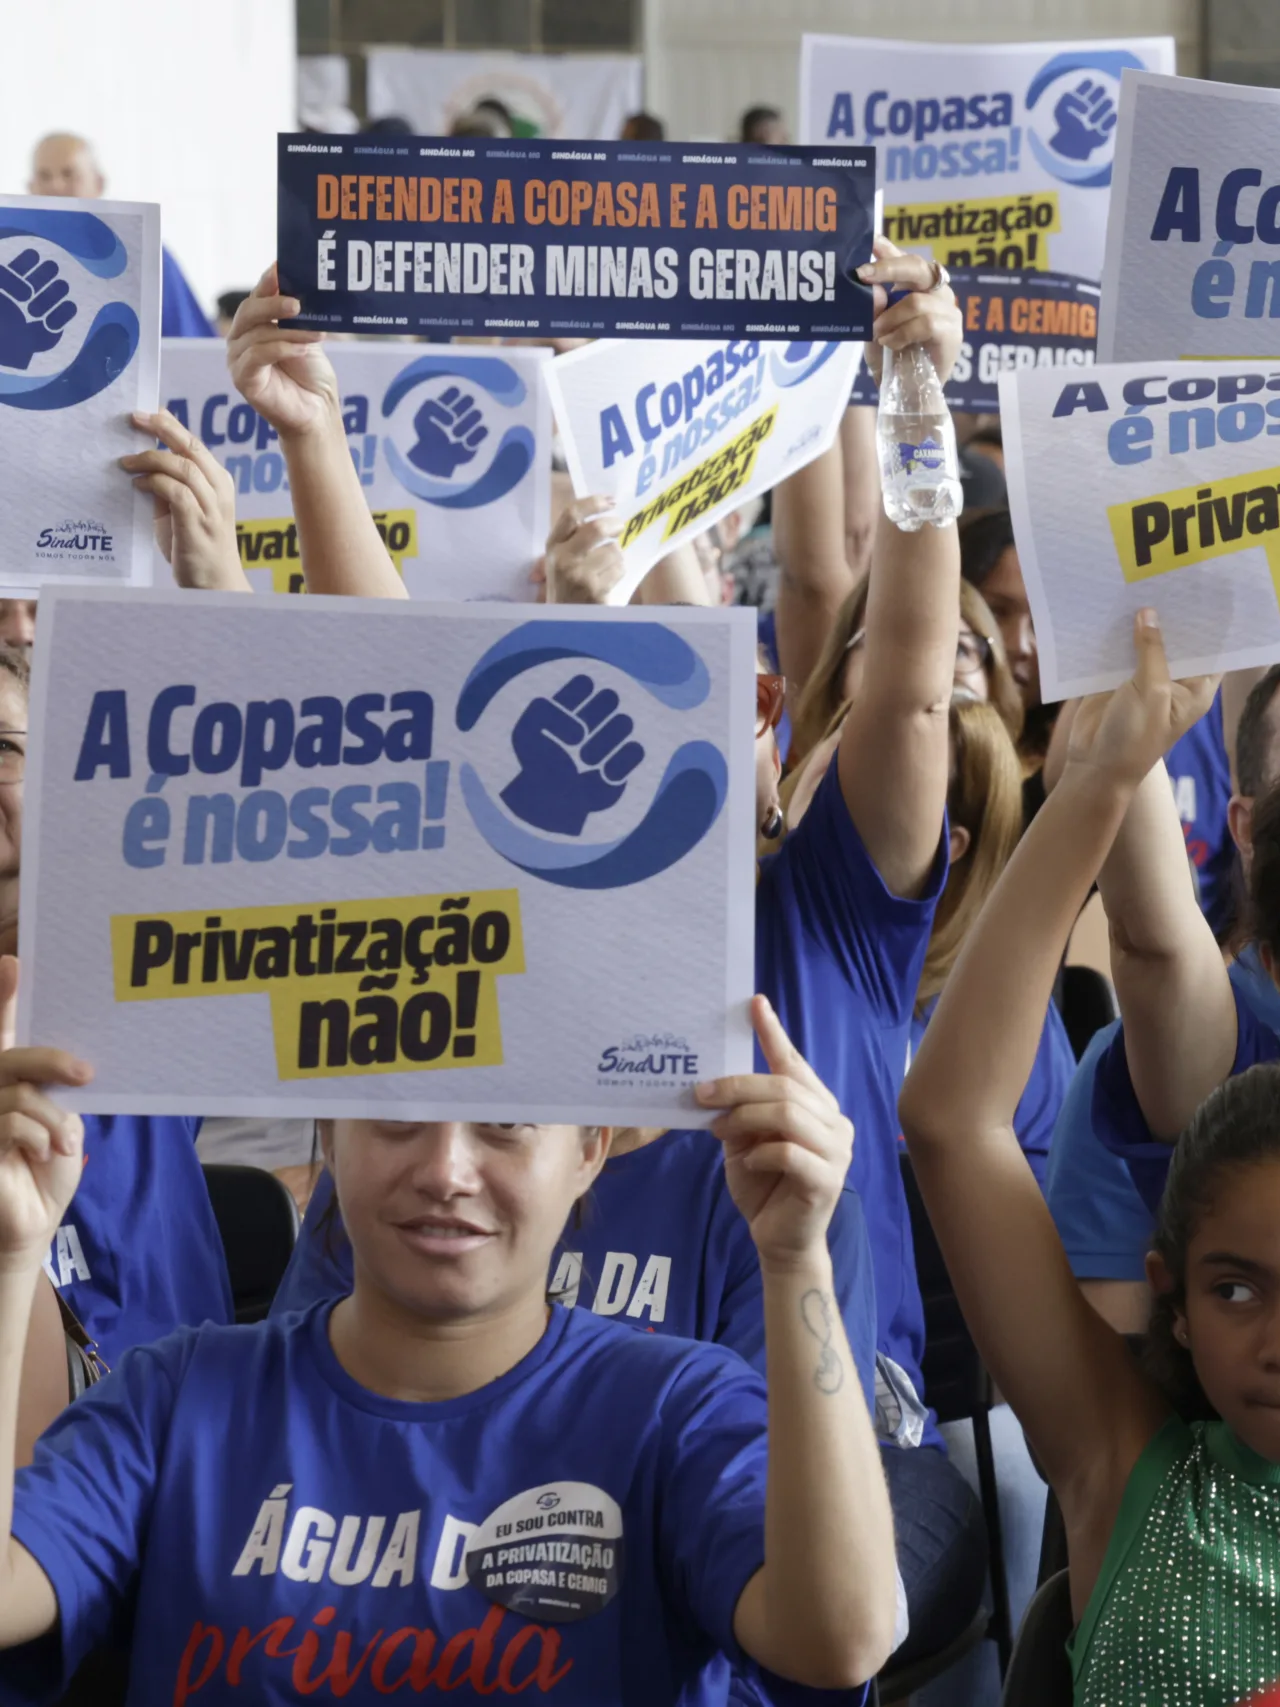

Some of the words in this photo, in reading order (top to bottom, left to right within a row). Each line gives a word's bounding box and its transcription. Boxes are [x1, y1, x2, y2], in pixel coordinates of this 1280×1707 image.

[826, 92, 855, 138] A
[864, 90, 1014, 142] Copasa
[884, 126, 1022, 182] nossa!
[317, 174, 483, 223] DEFENDER
[491, 178, 515, 224] A
[524, 179, 661, 228] COPASA
[670, 183, 687, 227] E
[695, 183, 718, 229] A
[727, 184, 837, 232] CEMIG
[884, 196, 1054, 240] rivatização
[1150, 166, 1201, 243] A
[317, 230, 336, 291] É
[347, 239, 535, 296] DEFENDER
[546, 245, 678, 299] MINAS
[689, 247, 836, 302] GERAIS!
[1190, 240, 1235, 319] é
[966, 296, 981, 331] E
[985, 297, 1004, 332] A
[1010, 298, 1097, 338] CEMIG
[201, 394, 369, 450] Copa
[600, 403, 634, 470] A
[635, 340, 760, 443] Copasa
[635, 441, 656, 498] é
[659, 352, 766, 480] nossa!
[1052, 381, 1109, 418] A
[1107, 404, 1154, 466] é
[621, 413, 774, 550] Privatização
[668, 449, 754, 537] não!
[36, 528, 113, 551] SindUTE
[73, 690, 131, 781] A
[147, 684, 434, 787] Copasa
[122, 773, 171, 869] é
[183, 760, 450, 865] nossa!
[130, 896, 511, 987] Privatização
[297, 970, 481, 1069] não!
[598, 1046, 698, 1075] SindUTE
[592, 1251, 672, 1322] DA
[231, 1483, 421, 1588] ÁGUA
[430, 1514, 481, 1591] D
[481, 1553, 494, 1570] A
[497, 1541, 614, 1571] PRIVATIZAÇÃO
[495, 1522, 512, 1538] EU
[516, 1515, 543, 1534] SOU
[548, 1510, 604, 1528] CONTRA
[486, 1572, 504, 1587] DA
[506, 1569, 556, 1587] COPASA
[558, 1572, 565, 1588] E
[567, 1573, 607, 1594] CEMIG
[173, 1605, 575, 1707] privada
